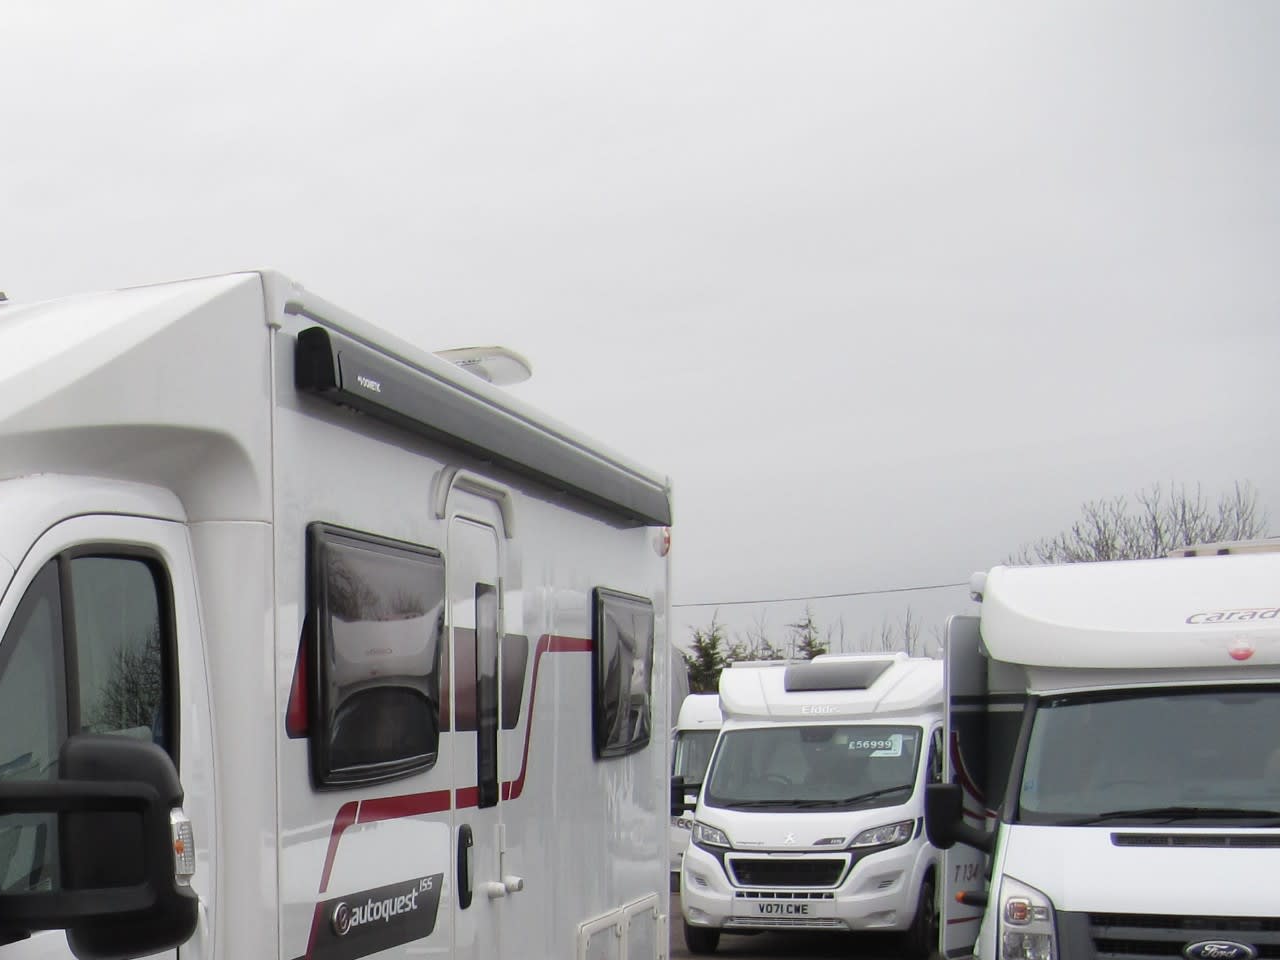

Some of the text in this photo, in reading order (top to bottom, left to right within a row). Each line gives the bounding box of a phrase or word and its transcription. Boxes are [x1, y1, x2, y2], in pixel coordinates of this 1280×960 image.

[848, 740, 892, 750] £56999
[351, 887, 419, 927] autoquest
[419, 877, 433, 893] 155
[1201, 944, 1238, 959] Ford
